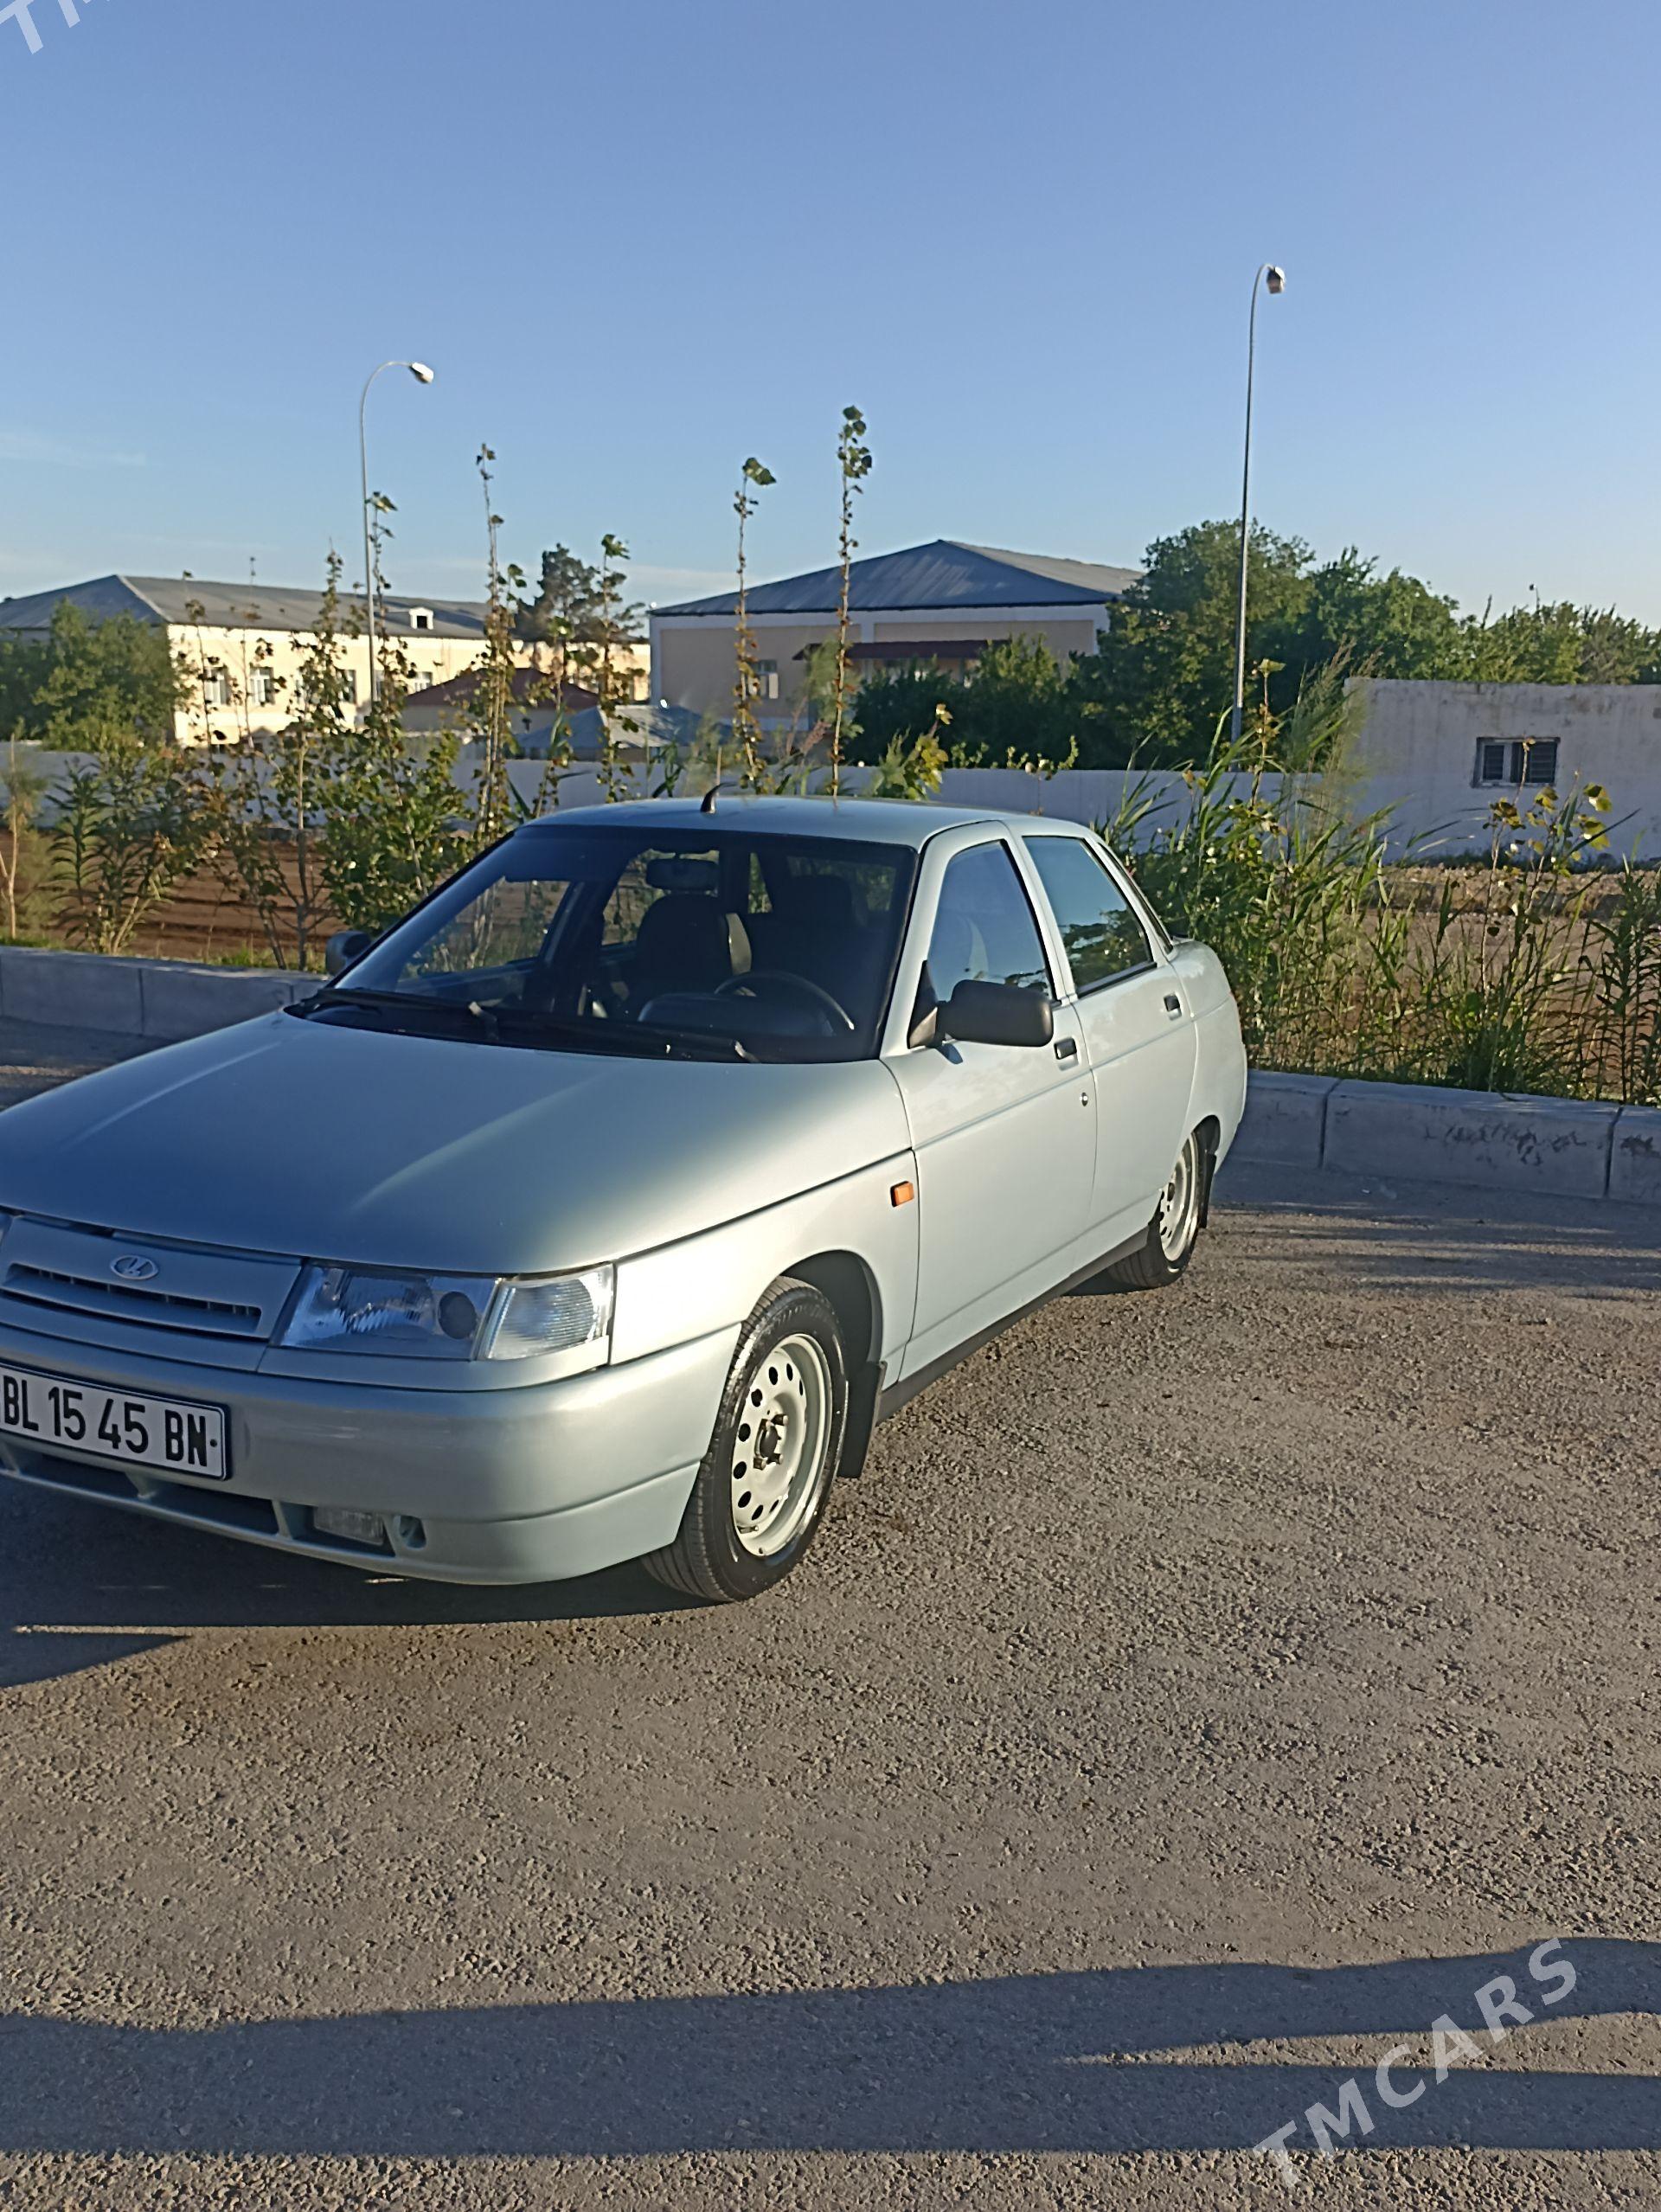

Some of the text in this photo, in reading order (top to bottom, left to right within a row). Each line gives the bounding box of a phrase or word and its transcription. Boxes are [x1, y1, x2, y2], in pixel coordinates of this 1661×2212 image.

[3, 1375, 208, 1467] BL 15 45 BN
